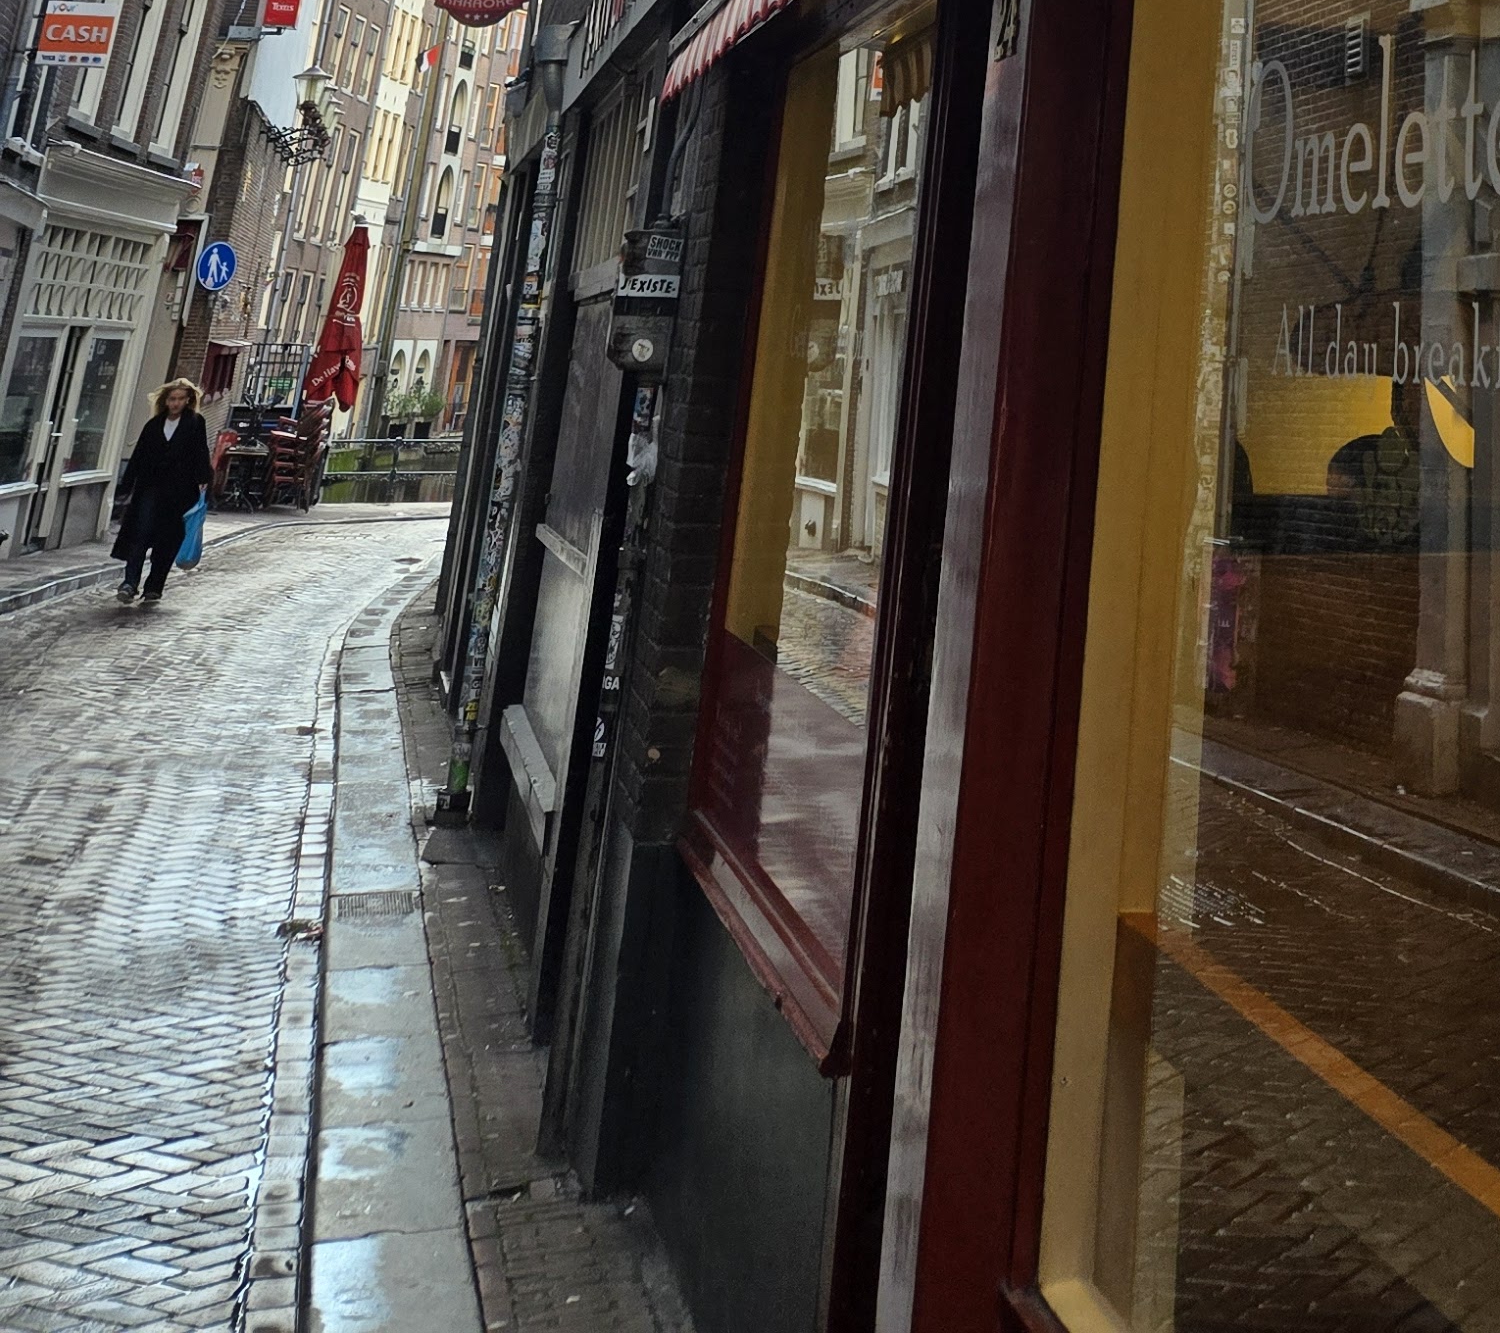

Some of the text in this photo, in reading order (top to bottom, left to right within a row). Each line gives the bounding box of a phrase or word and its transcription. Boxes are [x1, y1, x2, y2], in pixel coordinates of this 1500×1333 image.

[46, 24, 108, 43] CASH
[650, 236, 682, 252] SHOCK
[1271, 302, 1315, 377] All
